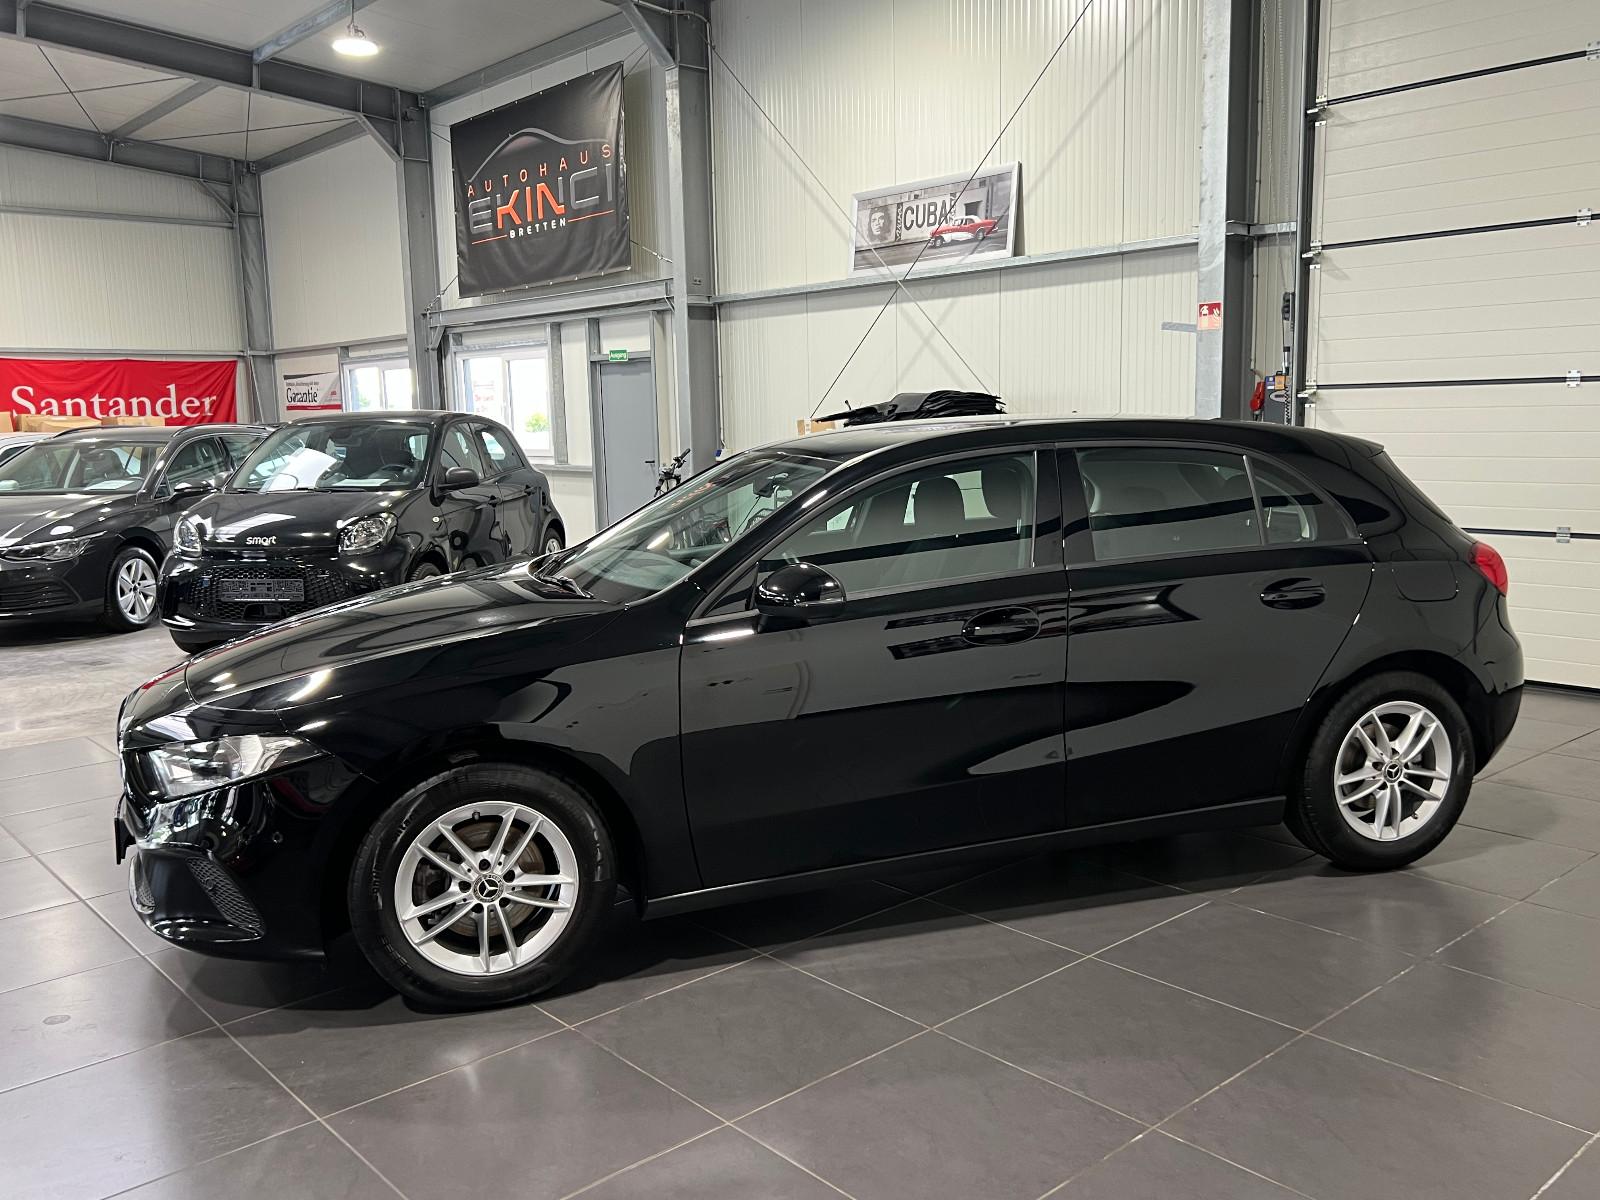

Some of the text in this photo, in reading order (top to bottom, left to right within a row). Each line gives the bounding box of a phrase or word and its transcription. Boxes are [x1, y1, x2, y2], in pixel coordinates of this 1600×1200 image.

[467, 144, 613, 197] AUTOHAUS
[509, 217, 566, 239] BRETTEN
[903, 199, 949, 231] CUBA
[11, 383, 217, 418] Santander
[246, 535, 277, 546] smart
